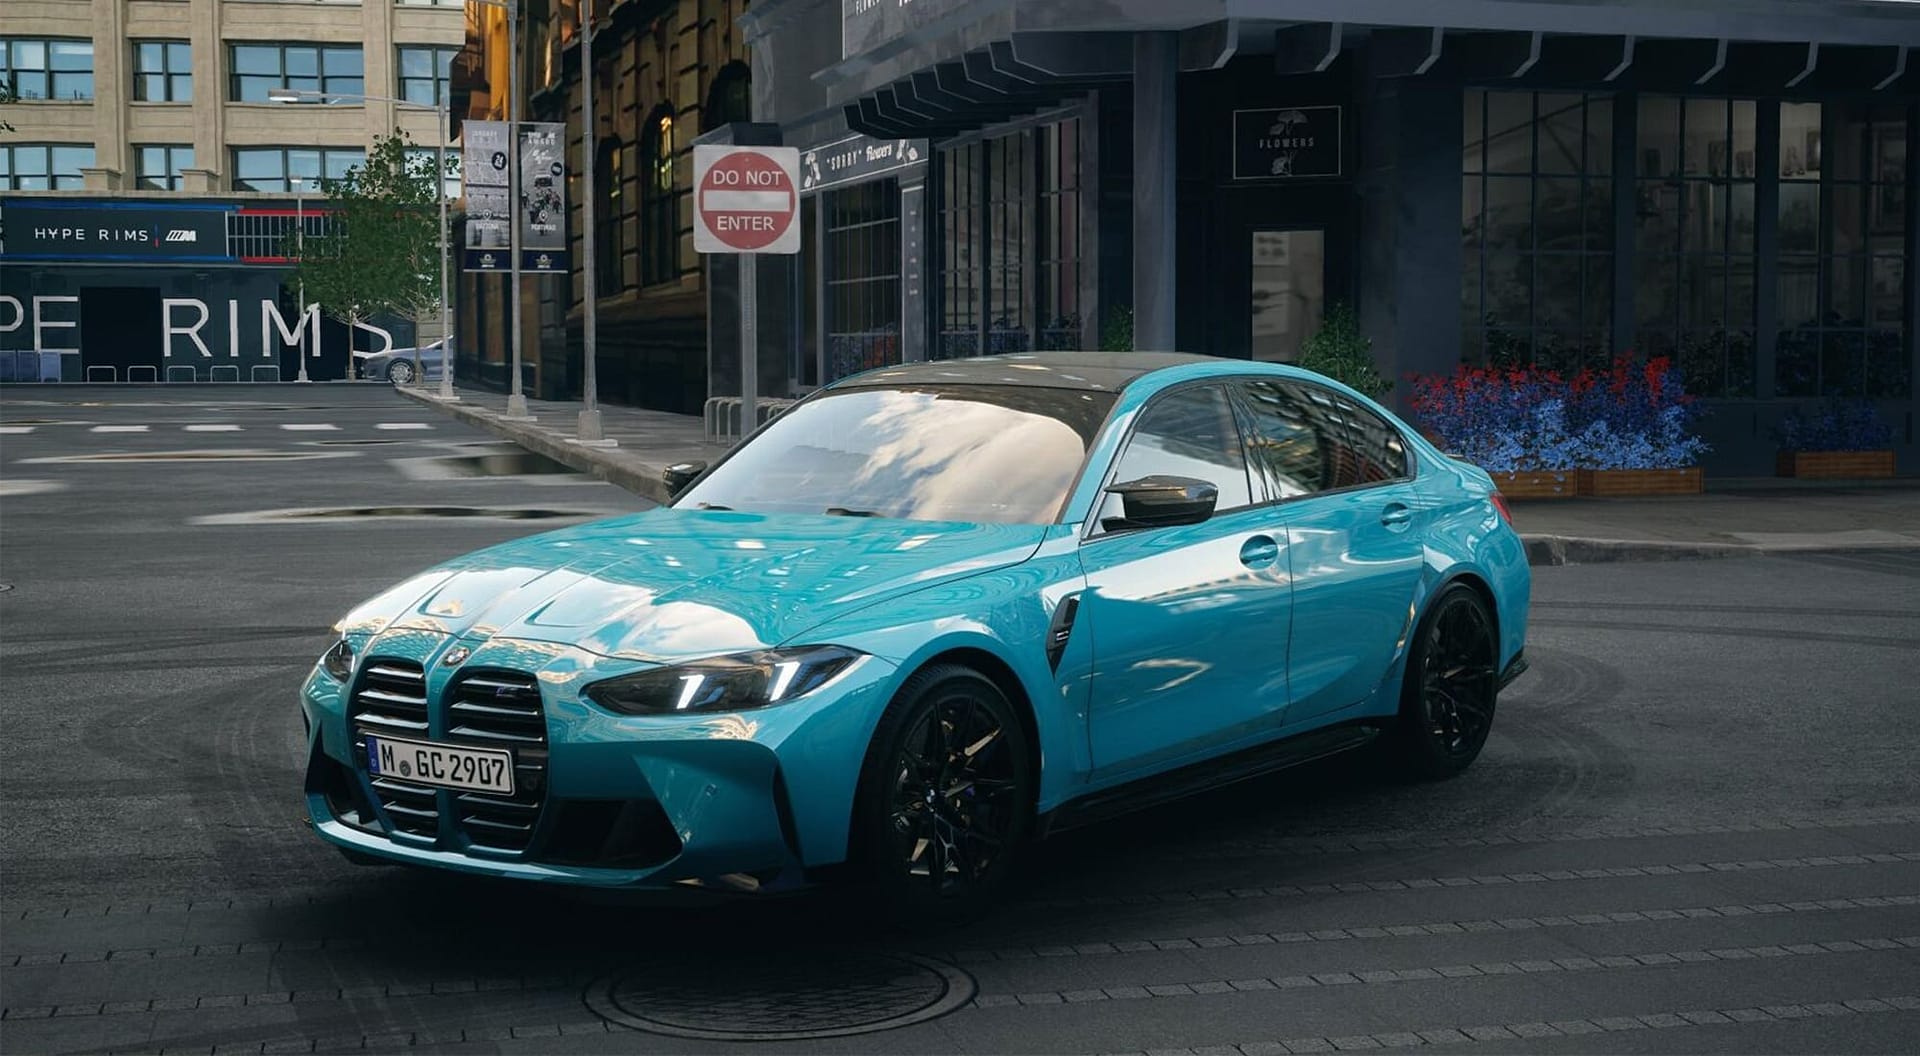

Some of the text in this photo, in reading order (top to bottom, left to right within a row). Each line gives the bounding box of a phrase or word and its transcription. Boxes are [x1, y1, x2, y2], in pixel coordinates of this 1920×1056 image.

[1259, 137, 1314, 149] FLOWERS
[713, 170, 783, 185] DO NOT
[717, 216, 775, 231] ENTER
[34, 228, 86, 241] HYPE
[99, 229, 149, 242] RIMS
[381, 743, 505, 787] M GC 2907
